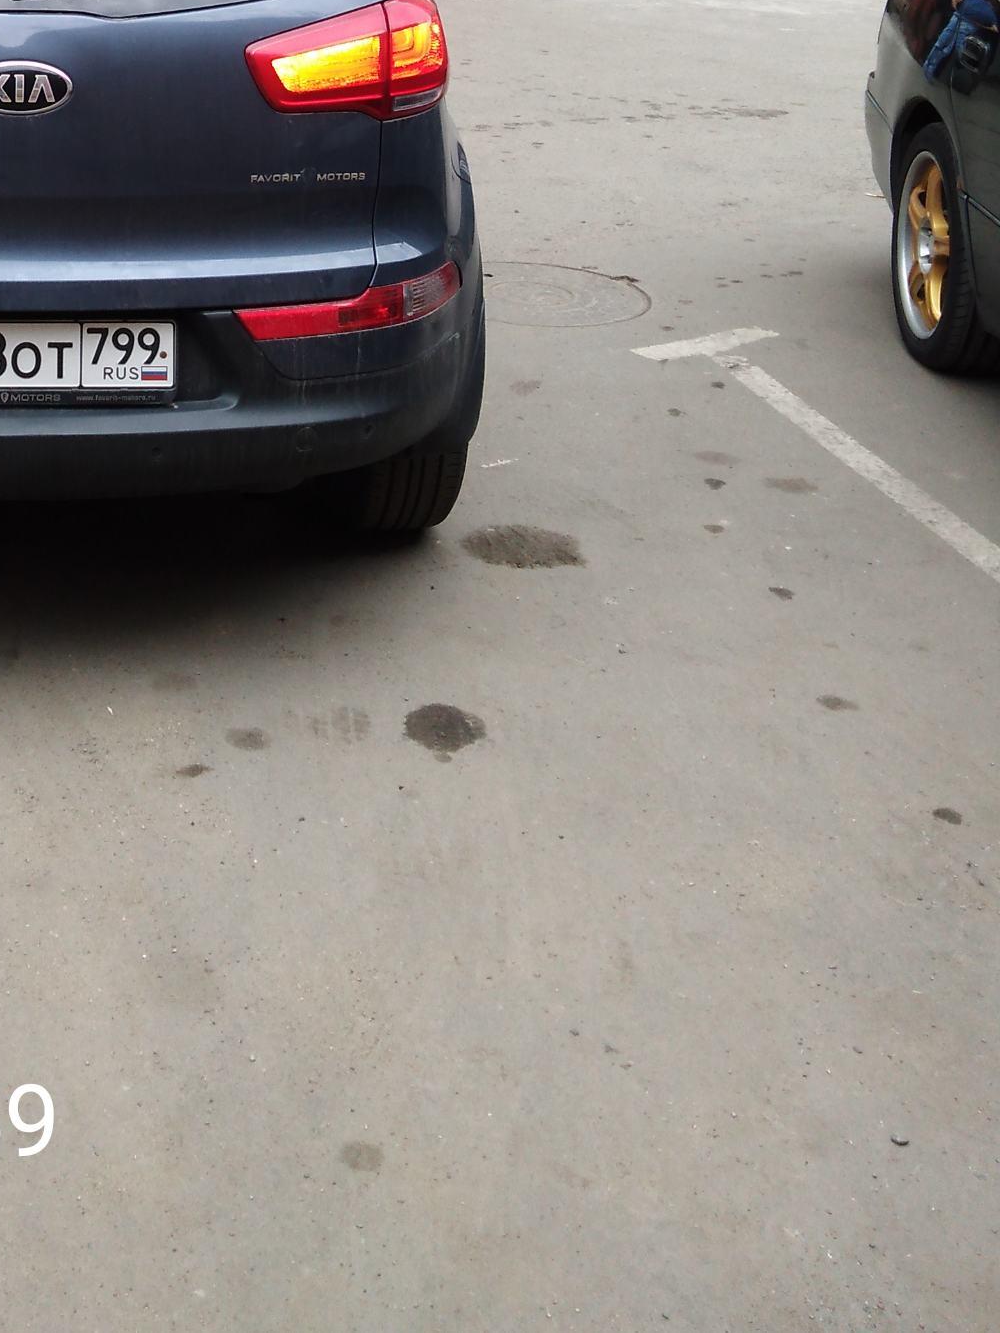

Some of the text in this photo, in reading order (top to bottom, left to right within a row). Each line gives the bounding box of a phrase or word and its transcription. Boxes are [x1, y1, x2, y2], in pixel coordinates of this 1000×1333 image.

[250, 172, 366, 183] FAVORIT MOTORS
[86, 327, 162, 365] 799
[103, 366, 140, 380] RUS
[10, 393, 61, 402] MOTORS
